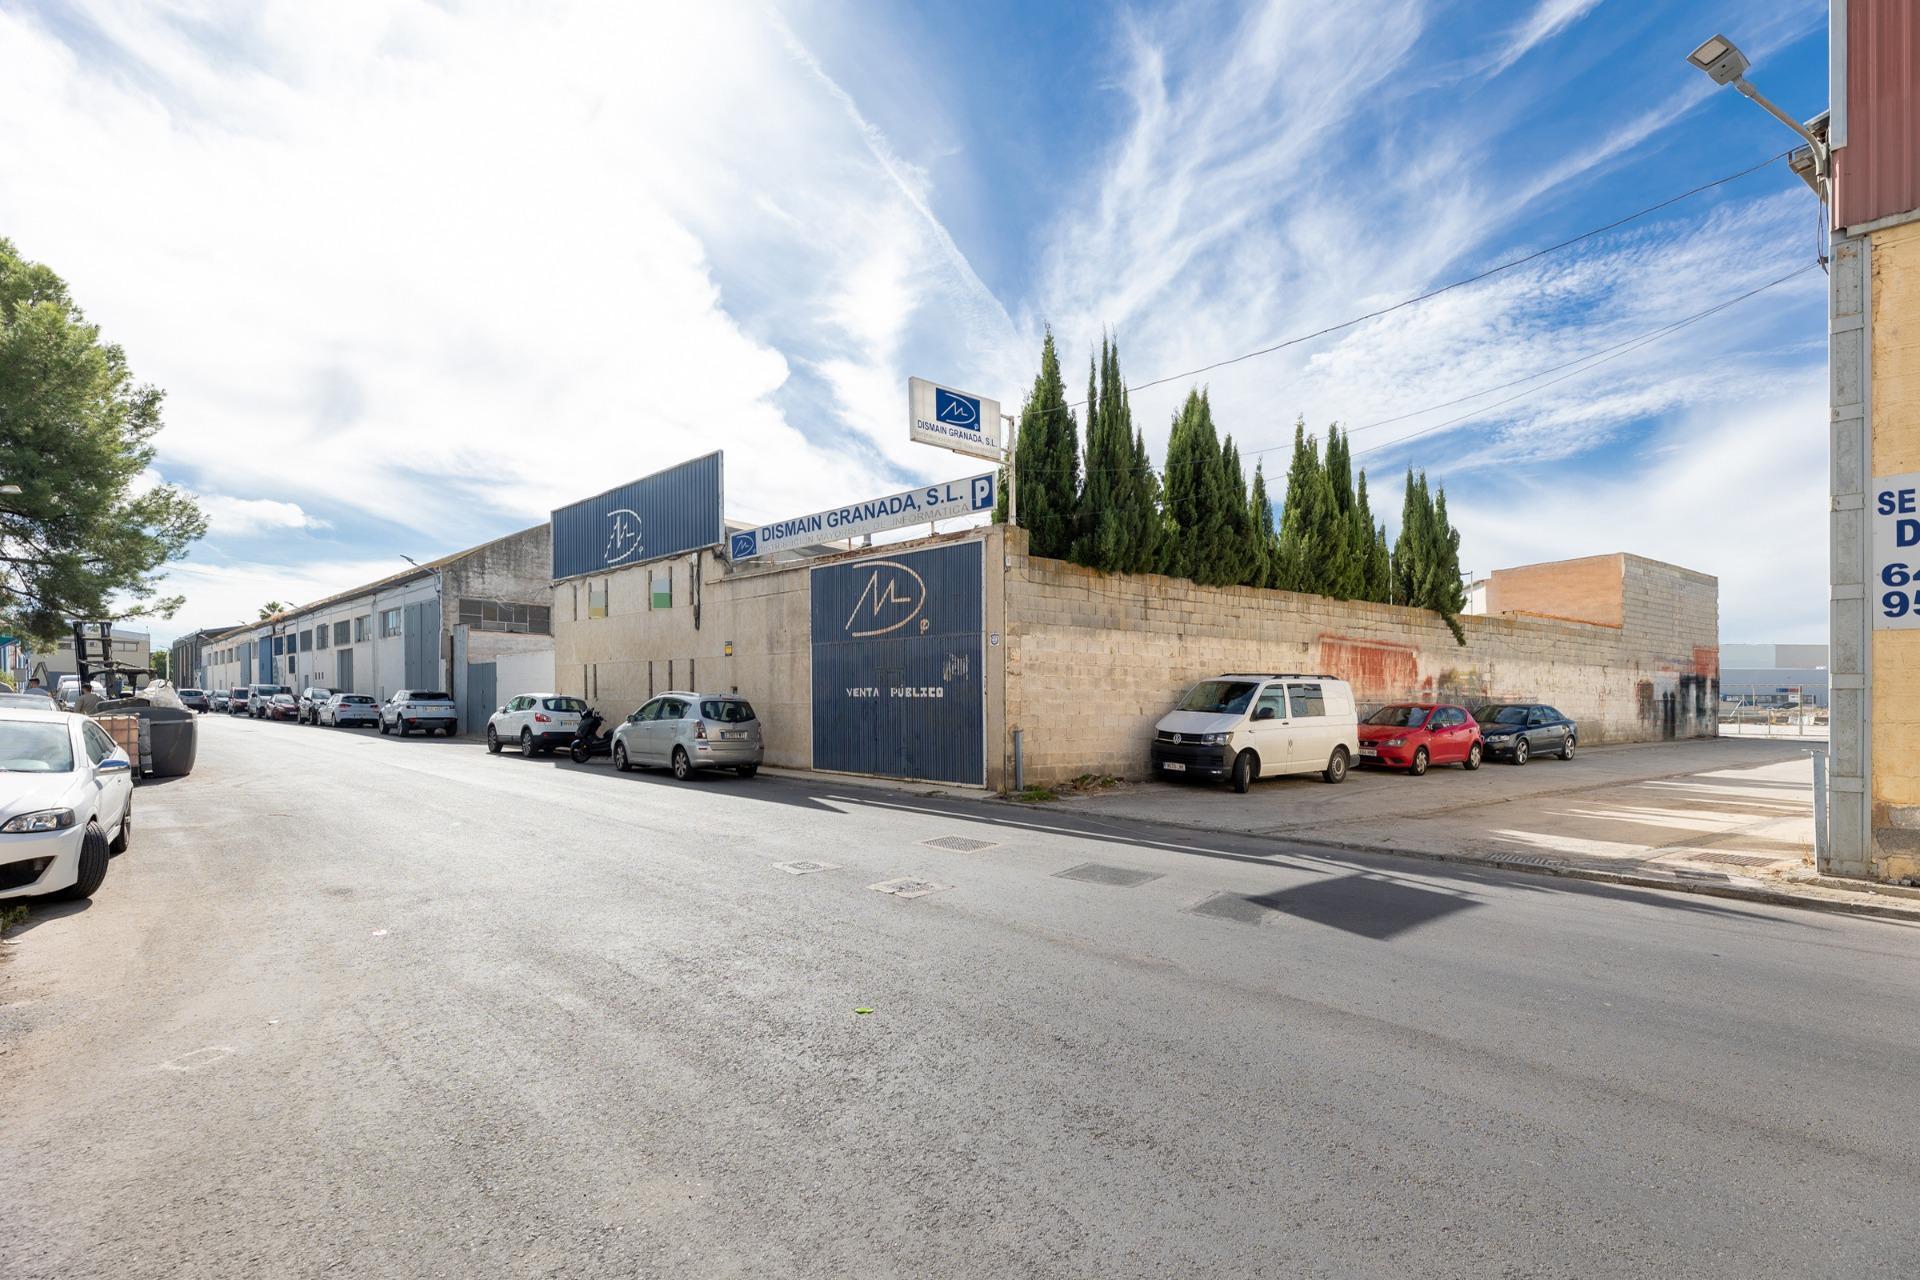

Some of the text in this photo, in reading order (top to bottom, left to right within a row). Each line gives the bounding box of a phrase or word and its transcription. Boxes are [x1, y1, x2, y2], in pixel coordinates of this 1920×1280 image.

[917, 419, 947, 435] DISMAIN
[948, 428, 984, 445] GRANADA,
[985, 437, 998, 448] S.L.
[975, 479, 990, 508] P
[762, 484, 964, 542] DISMAIN GRANADA, S.L.
[846, 687, 880, 698] VENTA
